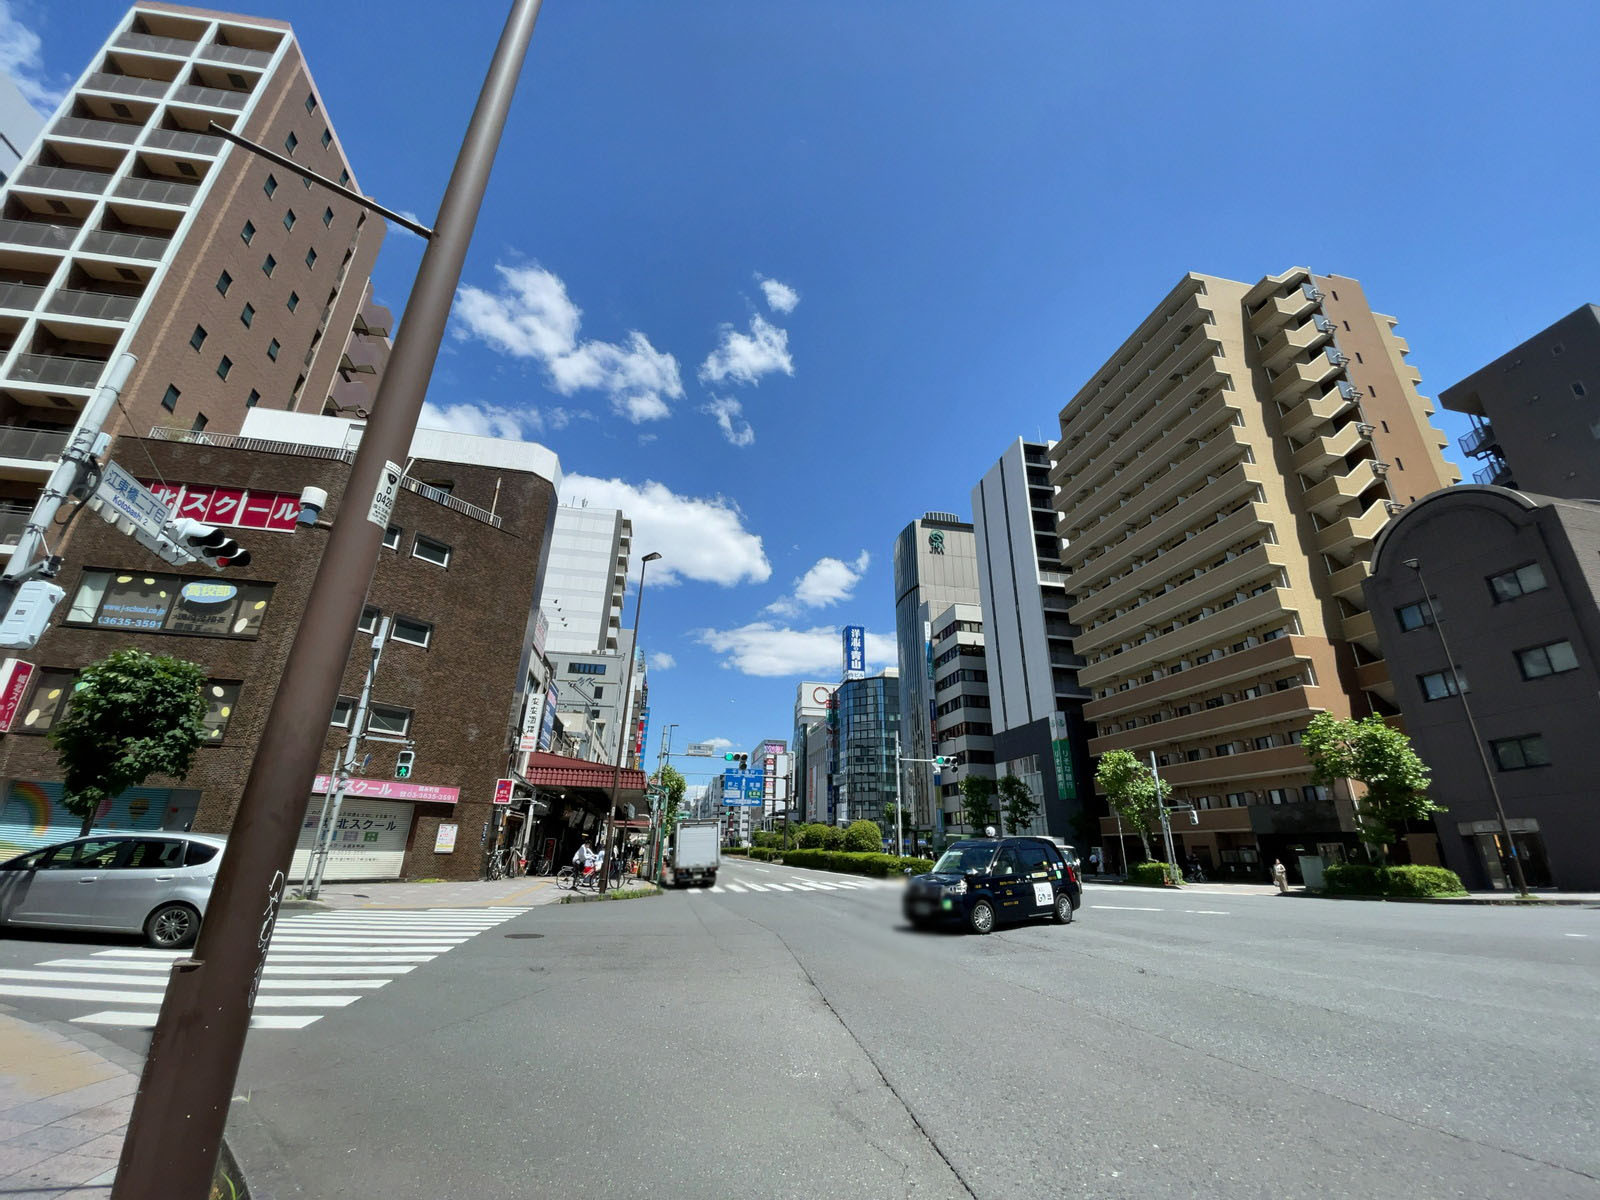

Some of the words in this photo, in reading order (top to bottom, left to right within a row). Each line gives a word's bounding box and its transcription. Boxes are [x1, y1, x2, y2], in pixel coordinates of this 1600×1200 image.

[104, 469, 166, 524] 江東橋二丁目
[148, 488, 300, 521] 北スクール
[386, 486, 392, 495] D
[112, 494, 143, 521] Kotobashi
[142, 518, 149, 527] 2
[929, 546, 944, 556] JRA
[850, 628, 862, 670] 洋服の青山
